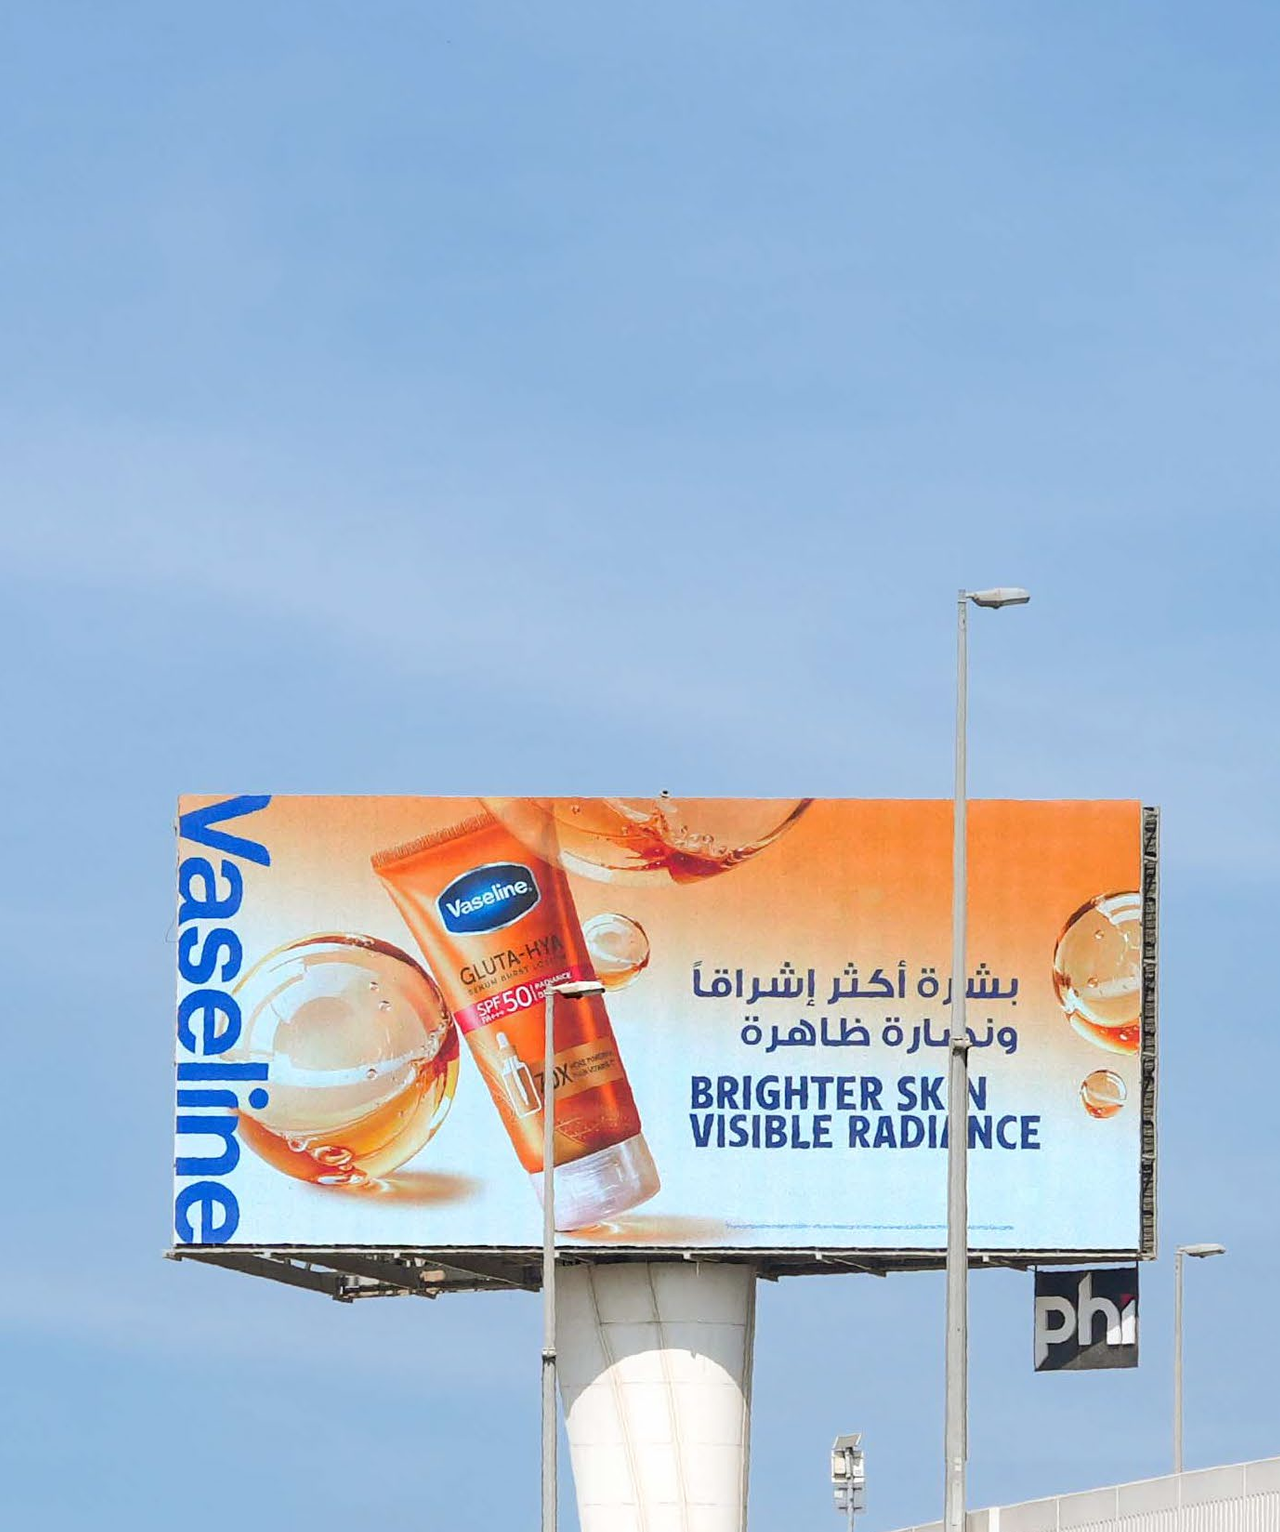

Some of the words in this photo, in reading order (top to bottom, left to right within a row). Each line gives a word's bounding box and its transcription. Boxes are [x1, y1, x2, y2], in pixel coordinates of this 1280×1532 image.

[445, 880, 528, 919] Vaseline
[459, 934, 564, 987] GLUTA-HYA
[476, 995, 502, 1017] SPF
[503, 985, 533, 1013] 50
[827, 959, 907, 1005] أكثر
[917, 962, 1019, 1006] بشرة
[175, 795, 271, 1245] Vaseline
[740, 1016, 871, 1053] ظاهرة
[690, 1075, 883, 1112] BRIGHTER
[896, 1075, 987, 1112] SKN
[689, 1113, 834, 1149] VISIBLE
[1035, 1271, 1136, 1369] phi
